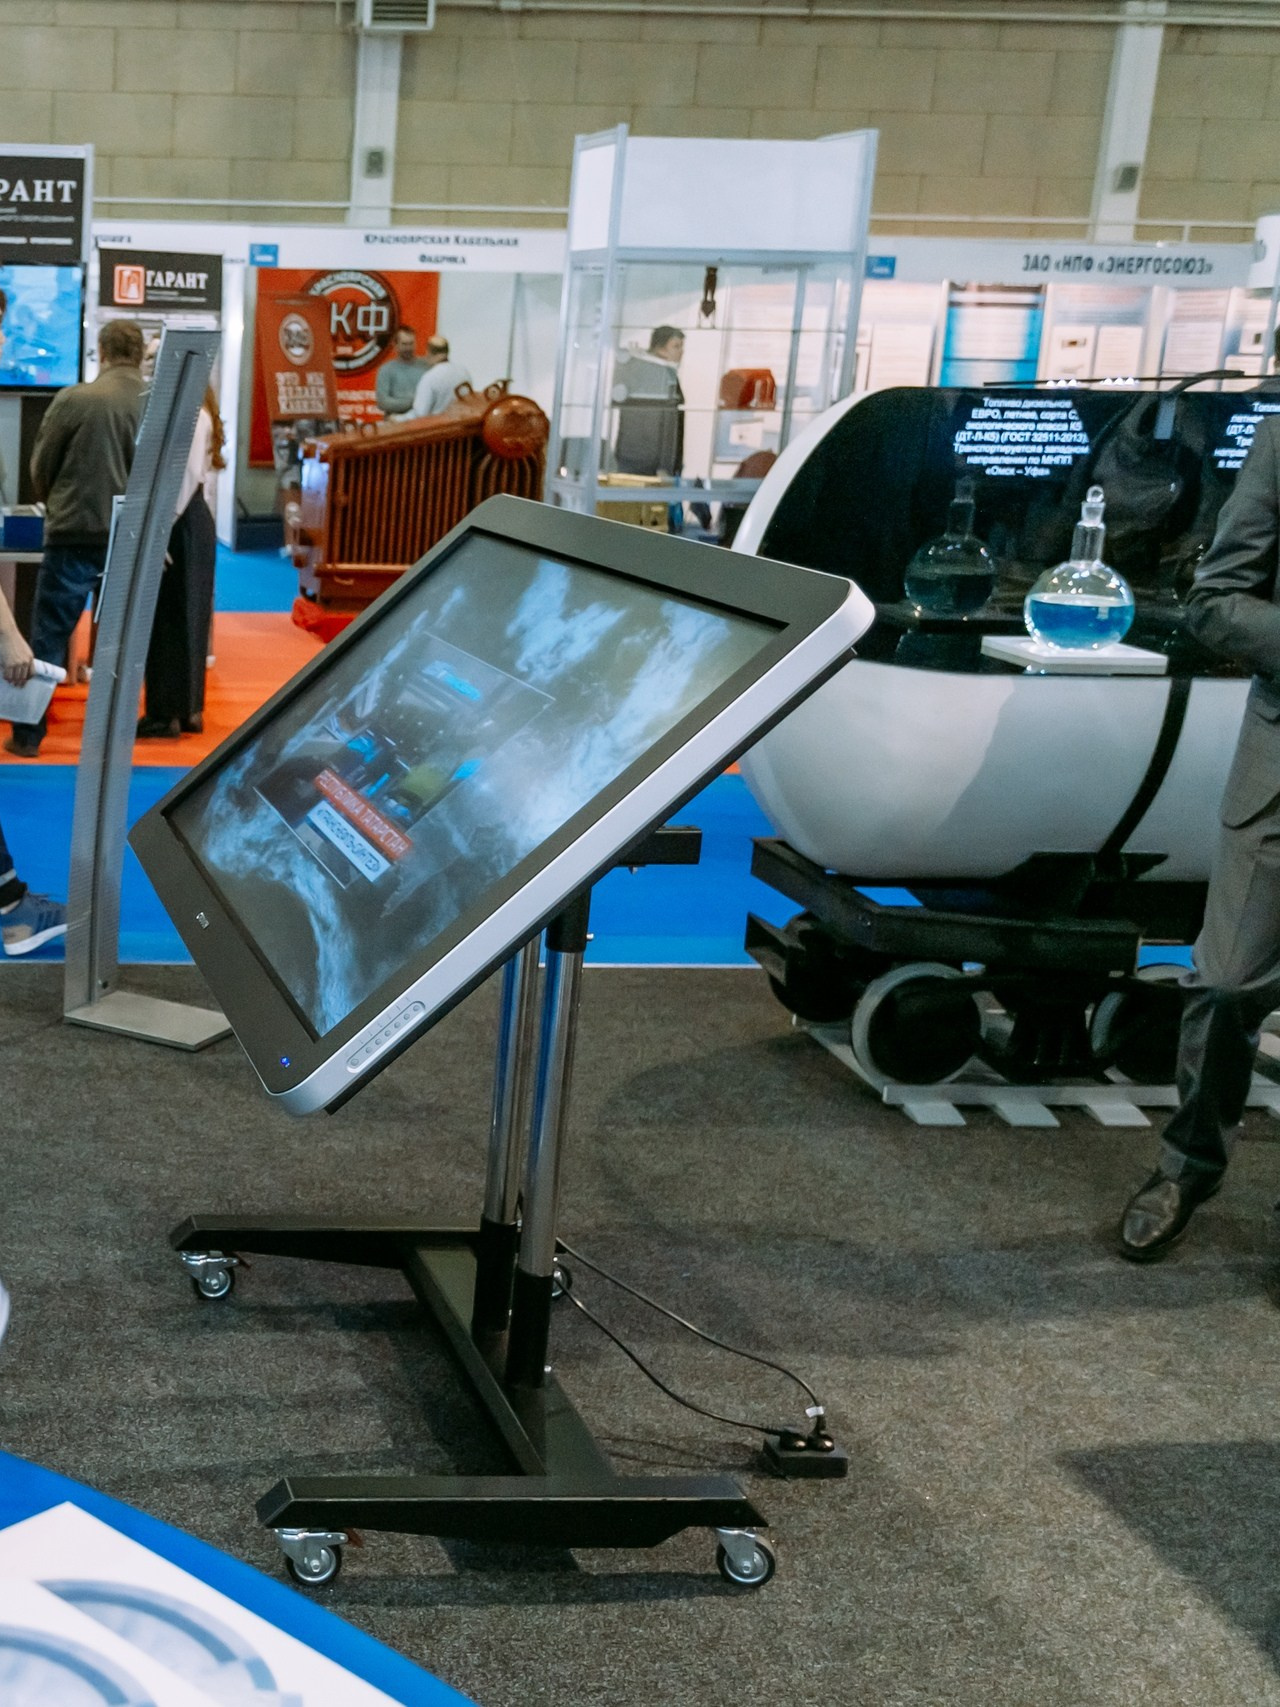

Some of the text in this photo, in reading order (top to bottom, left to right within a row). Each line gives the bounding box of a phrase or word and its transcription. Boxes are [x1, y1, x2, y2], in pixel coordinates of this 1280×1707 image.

[1022, 254, 1214, 275] ЗАО «НПФ «ЭНЕРГОСОЮЗ»
[145, 269, 209, 290] ГАРАНТ
